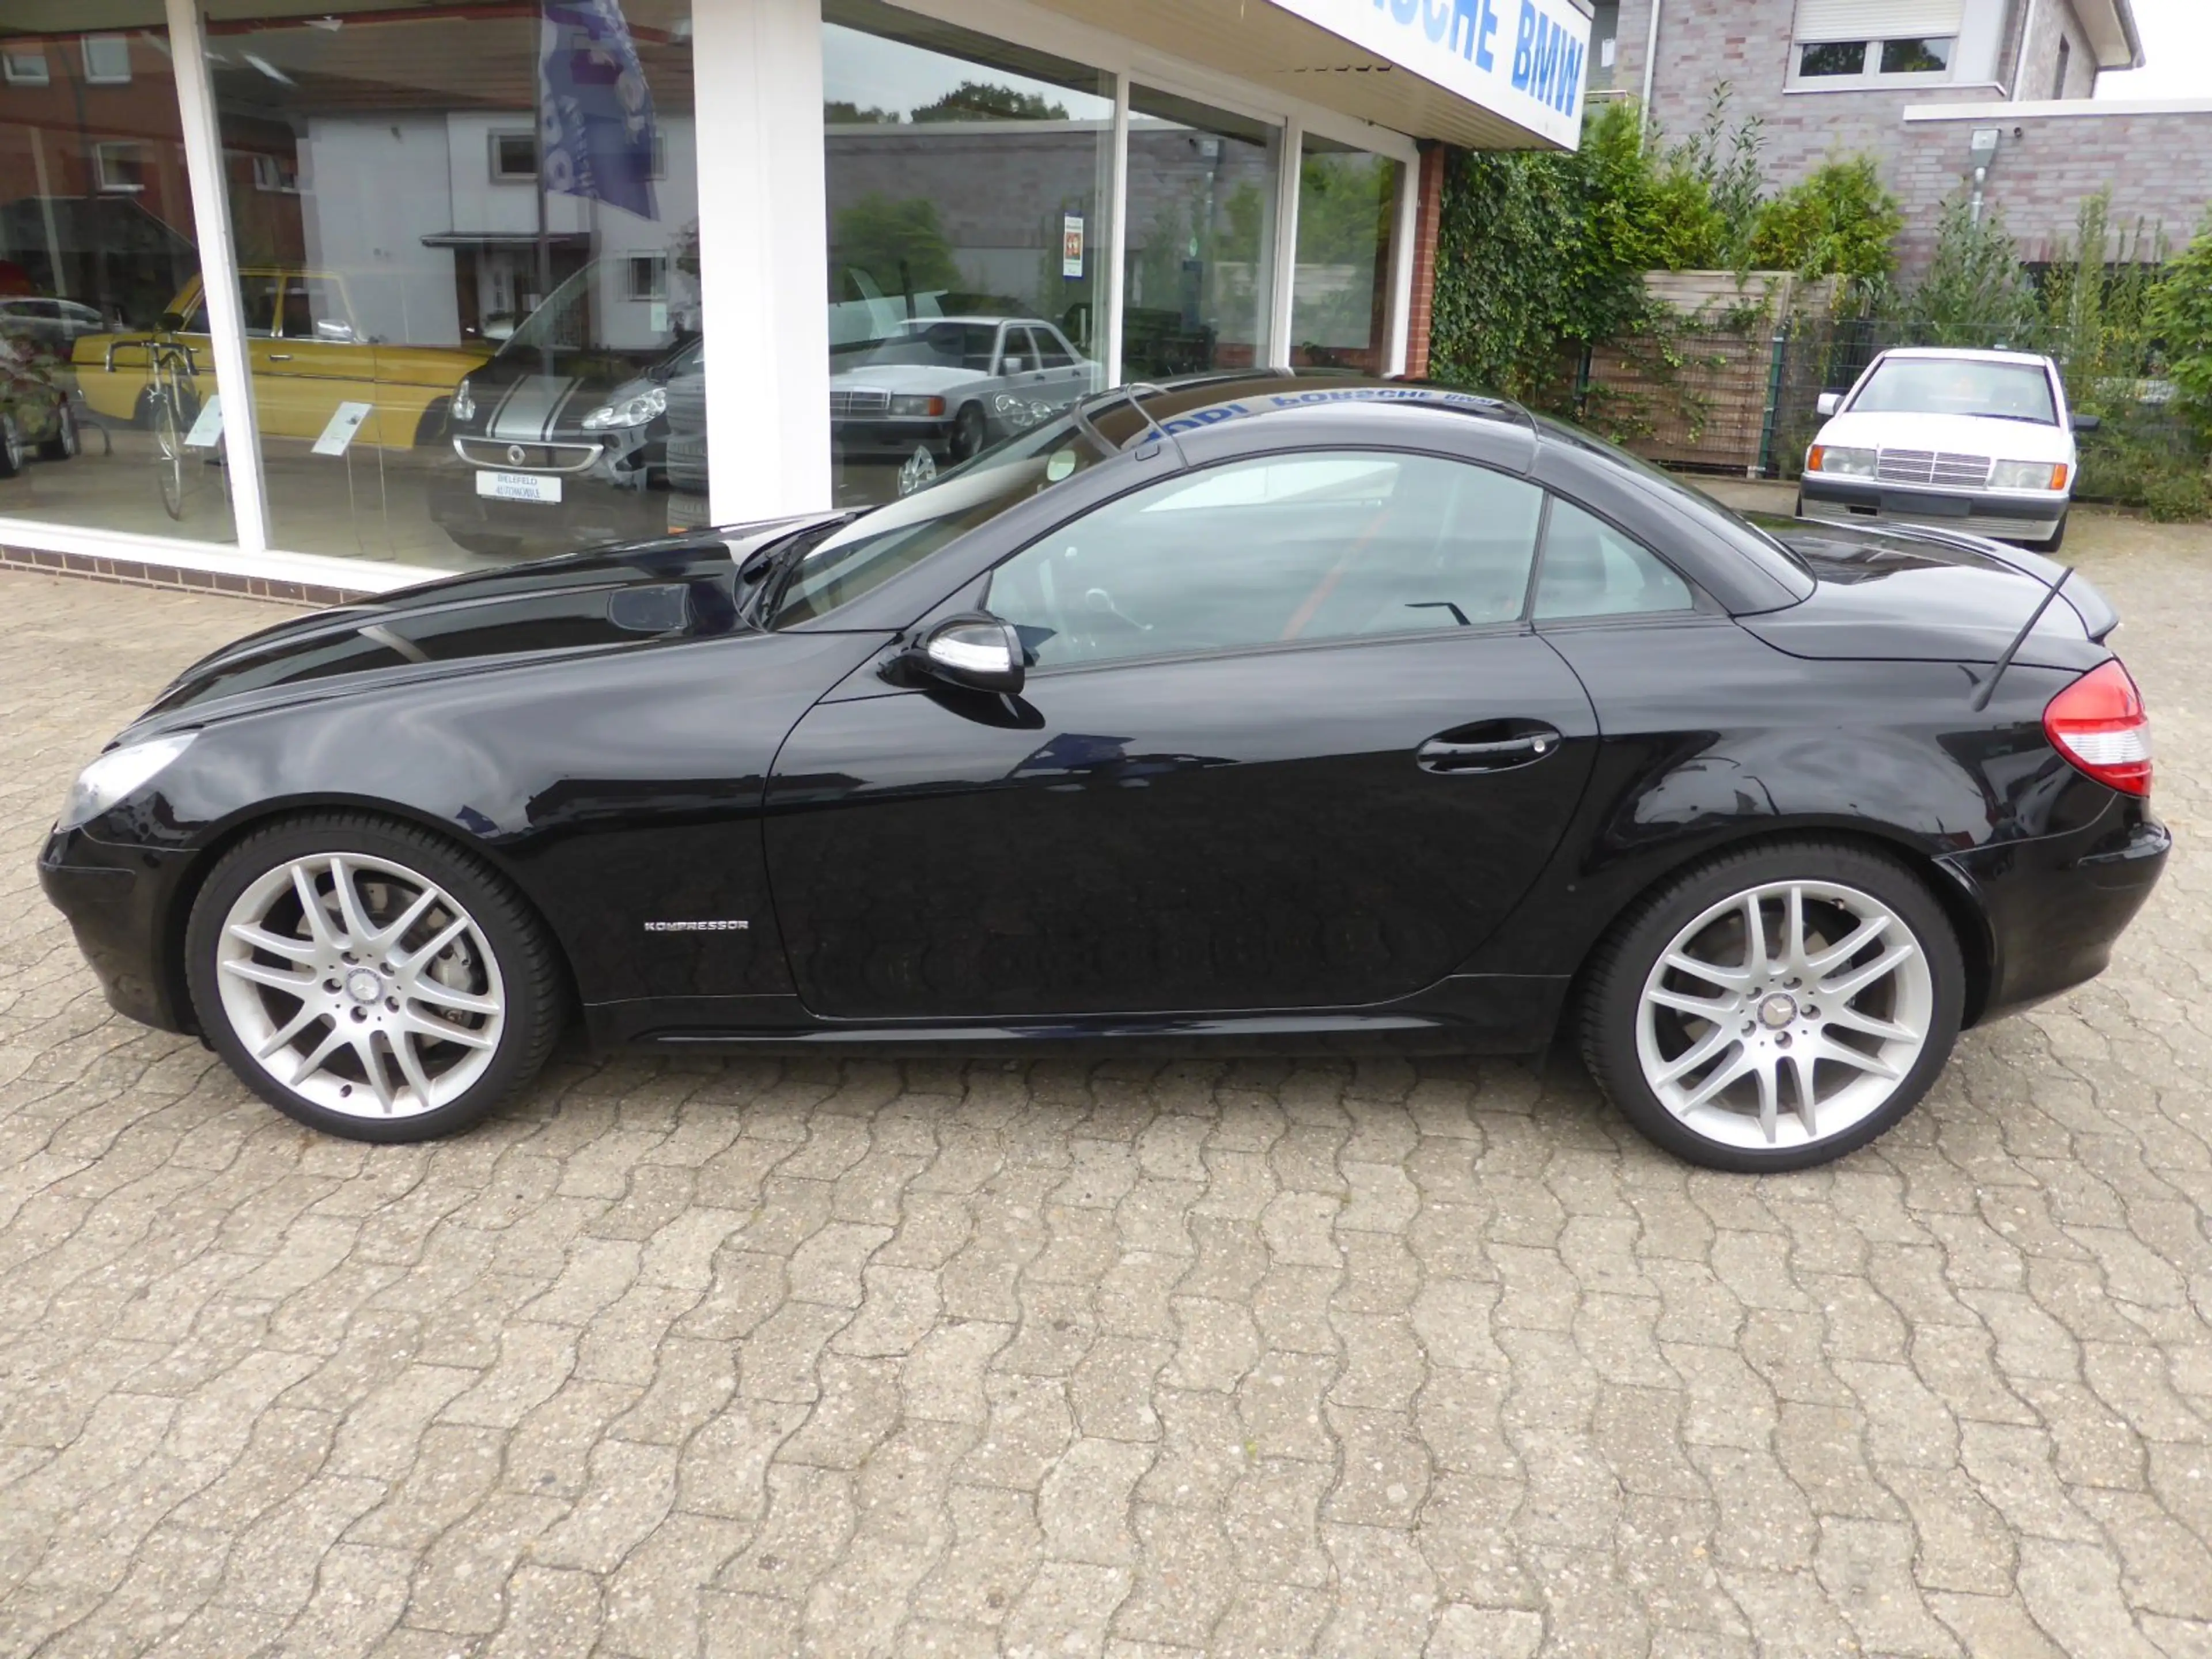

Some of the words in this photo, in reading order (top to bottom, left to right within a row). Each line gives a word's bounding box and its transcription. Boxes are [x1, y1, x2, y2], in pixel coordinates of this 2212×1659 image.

[1511, 0, 1584, 118] BMW
[497, 473, 538, 486] BIELEFELD
[643, 920, 749, 931] KOMPRESSOR
